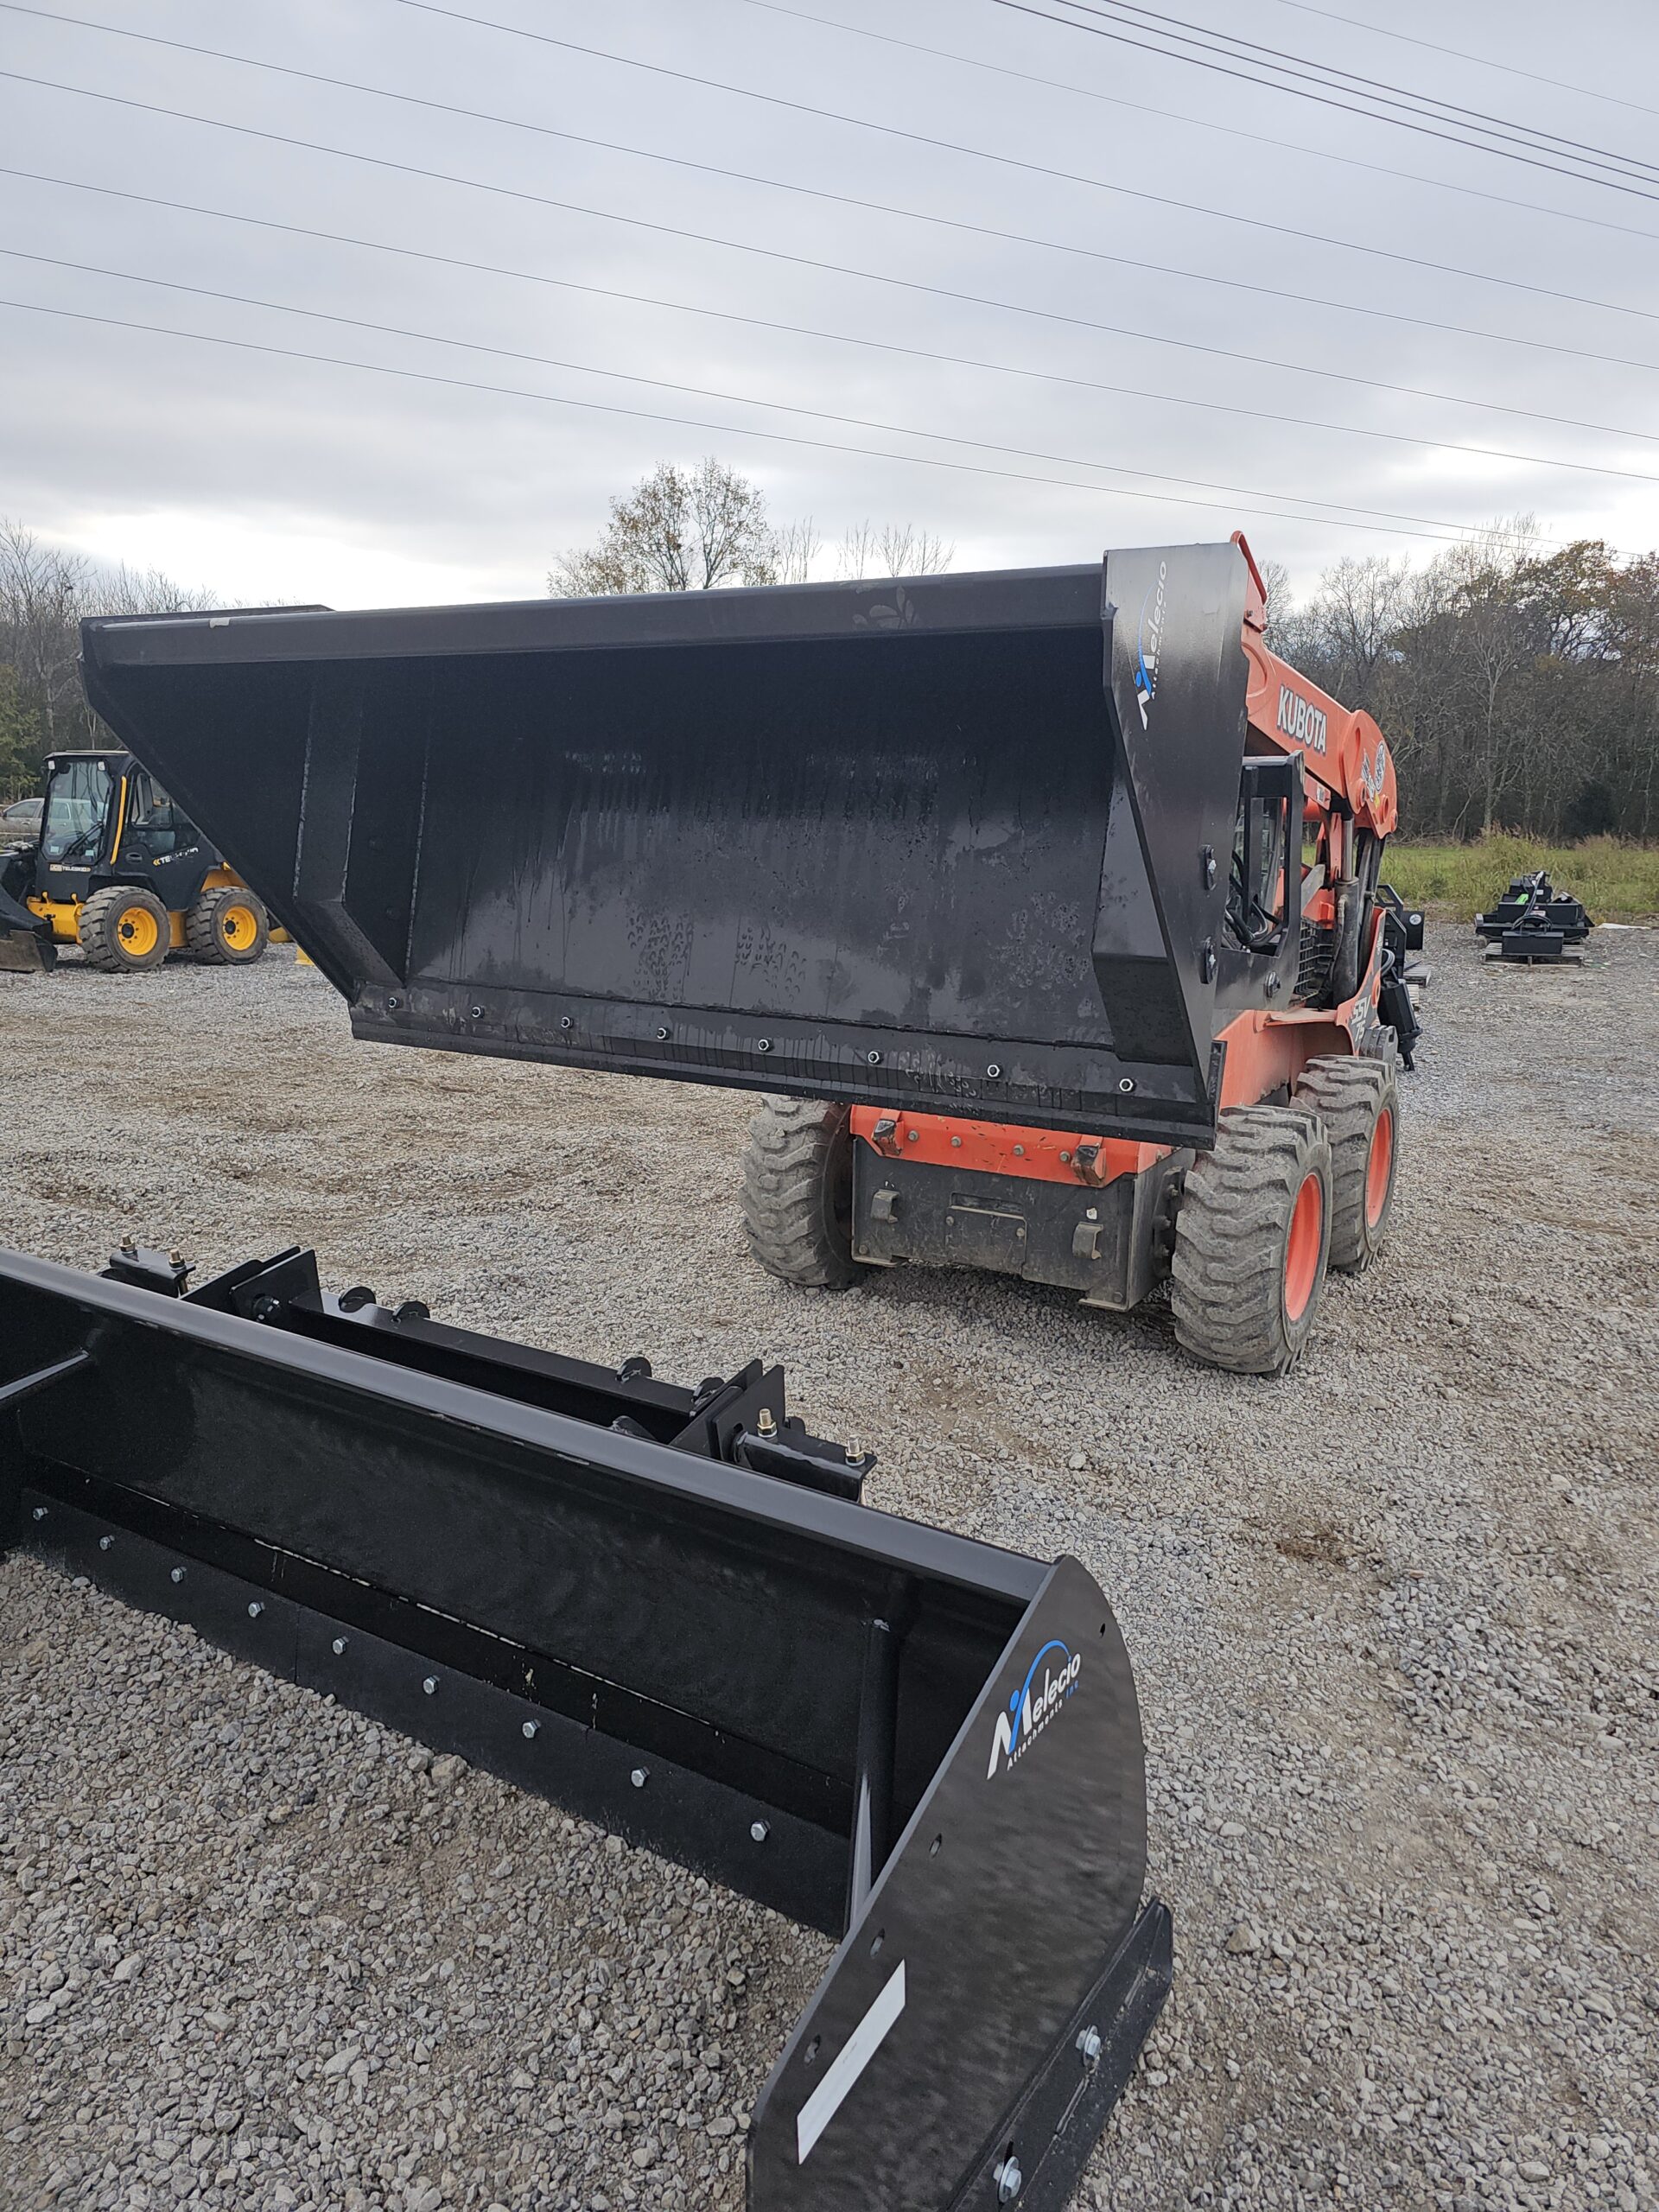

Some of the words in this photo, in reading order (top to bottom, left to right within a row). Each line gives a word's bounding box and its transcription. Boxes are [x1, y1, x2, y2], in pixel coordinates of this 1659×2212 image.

[1277, 683, 1327, 754] KUBOTA
[1351, 995, 1371, 1025] SSV
[987, 1647, 1081, 1780] Melecio
[1007, 1699, 1063, 1771] Attachments
